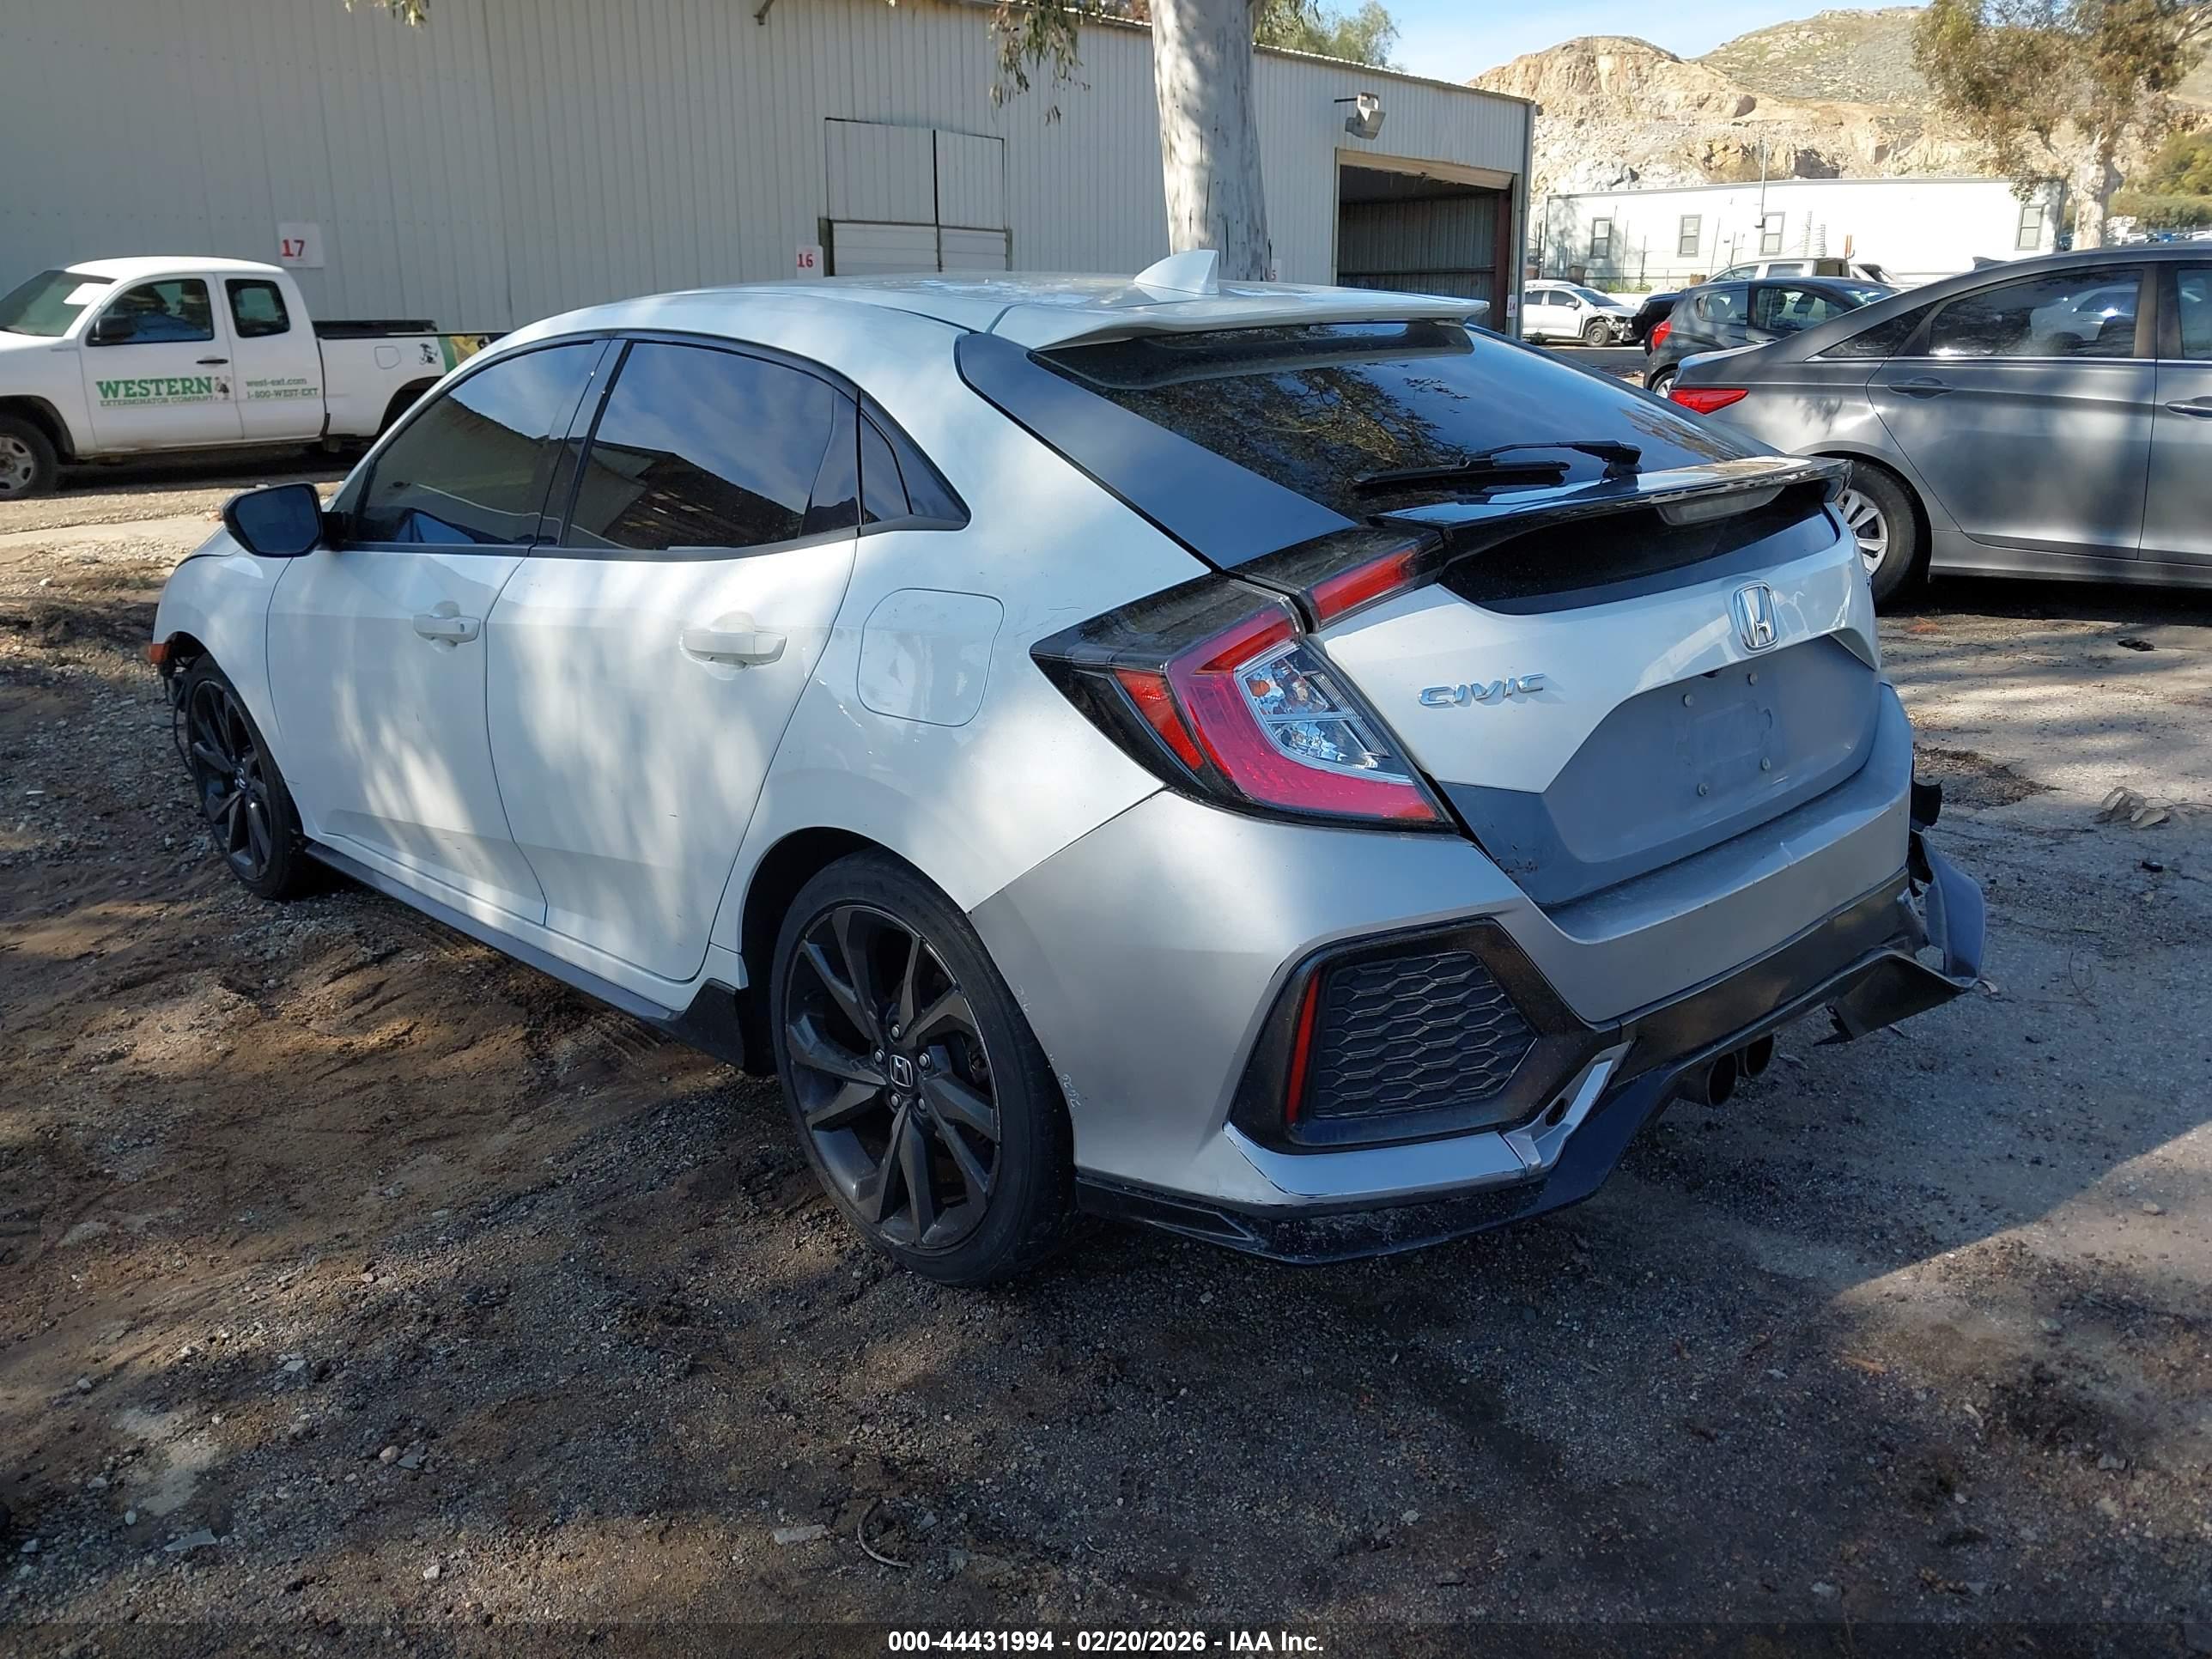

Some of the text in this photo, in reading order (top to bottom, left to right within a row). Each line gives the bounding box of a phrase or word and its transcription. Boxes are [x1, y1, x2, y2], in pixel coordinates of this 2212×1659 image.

[282, 239, 305, 258] 17
[798, 253, 813, 268] 16
[96, 376, 212, 399] WESTERN
[246, 378, 307, 386] west-ext.com
[246, 387, 318, 399] 1-800-WEST-EXT
[100, 395, 214, 407] EXTERMINATOR COMPANY
[1418, 673, 1545, 706] CIVIC
